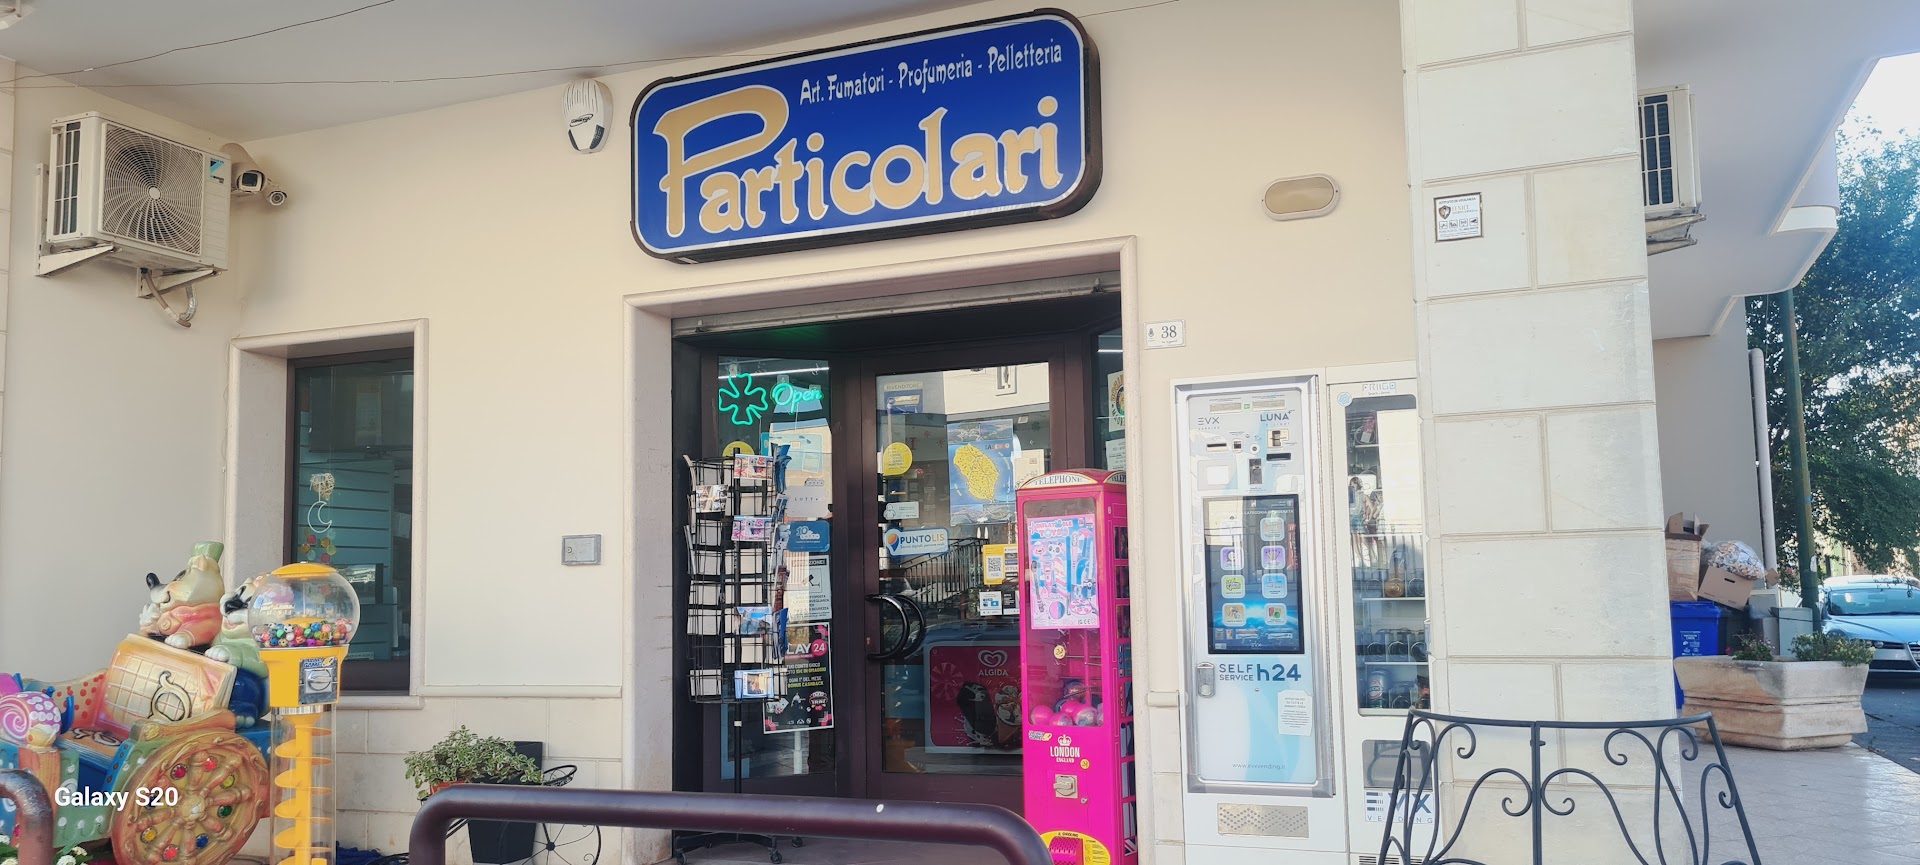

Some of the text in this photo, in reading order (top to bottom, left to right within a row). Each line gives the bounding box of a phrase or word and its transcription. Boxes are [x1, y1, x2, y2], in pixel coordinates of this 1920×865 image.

[800, 79, 825, 105] Art.
[827, 67, 885, 101] Fumatori
[898, 58, 973, 94] Profumeria
[987, 38, 1062, 74] Pelletteria
[652, 85, 1063, 238] Particolari
[1161, 325, 1177, 338] 38
[771, 382, 822, 414] Open
[1198, 416, 1220, 425] EVX
[900, 534, 945, 544] PUNTOLIS
[786, 642, 812, 655] LAY
[813, 643, 825, 653] 24
[978, 669, 1009, 677] ALGIDA
[1219, 663, 1254, 674] SELF
[1256, 663, 1302, 682] h24
[1219, 674, 1254, 682] SERVICE
[1050, 746, 1080, 758] LONDON
[1367, 815, 1433, 824] VEDNG
